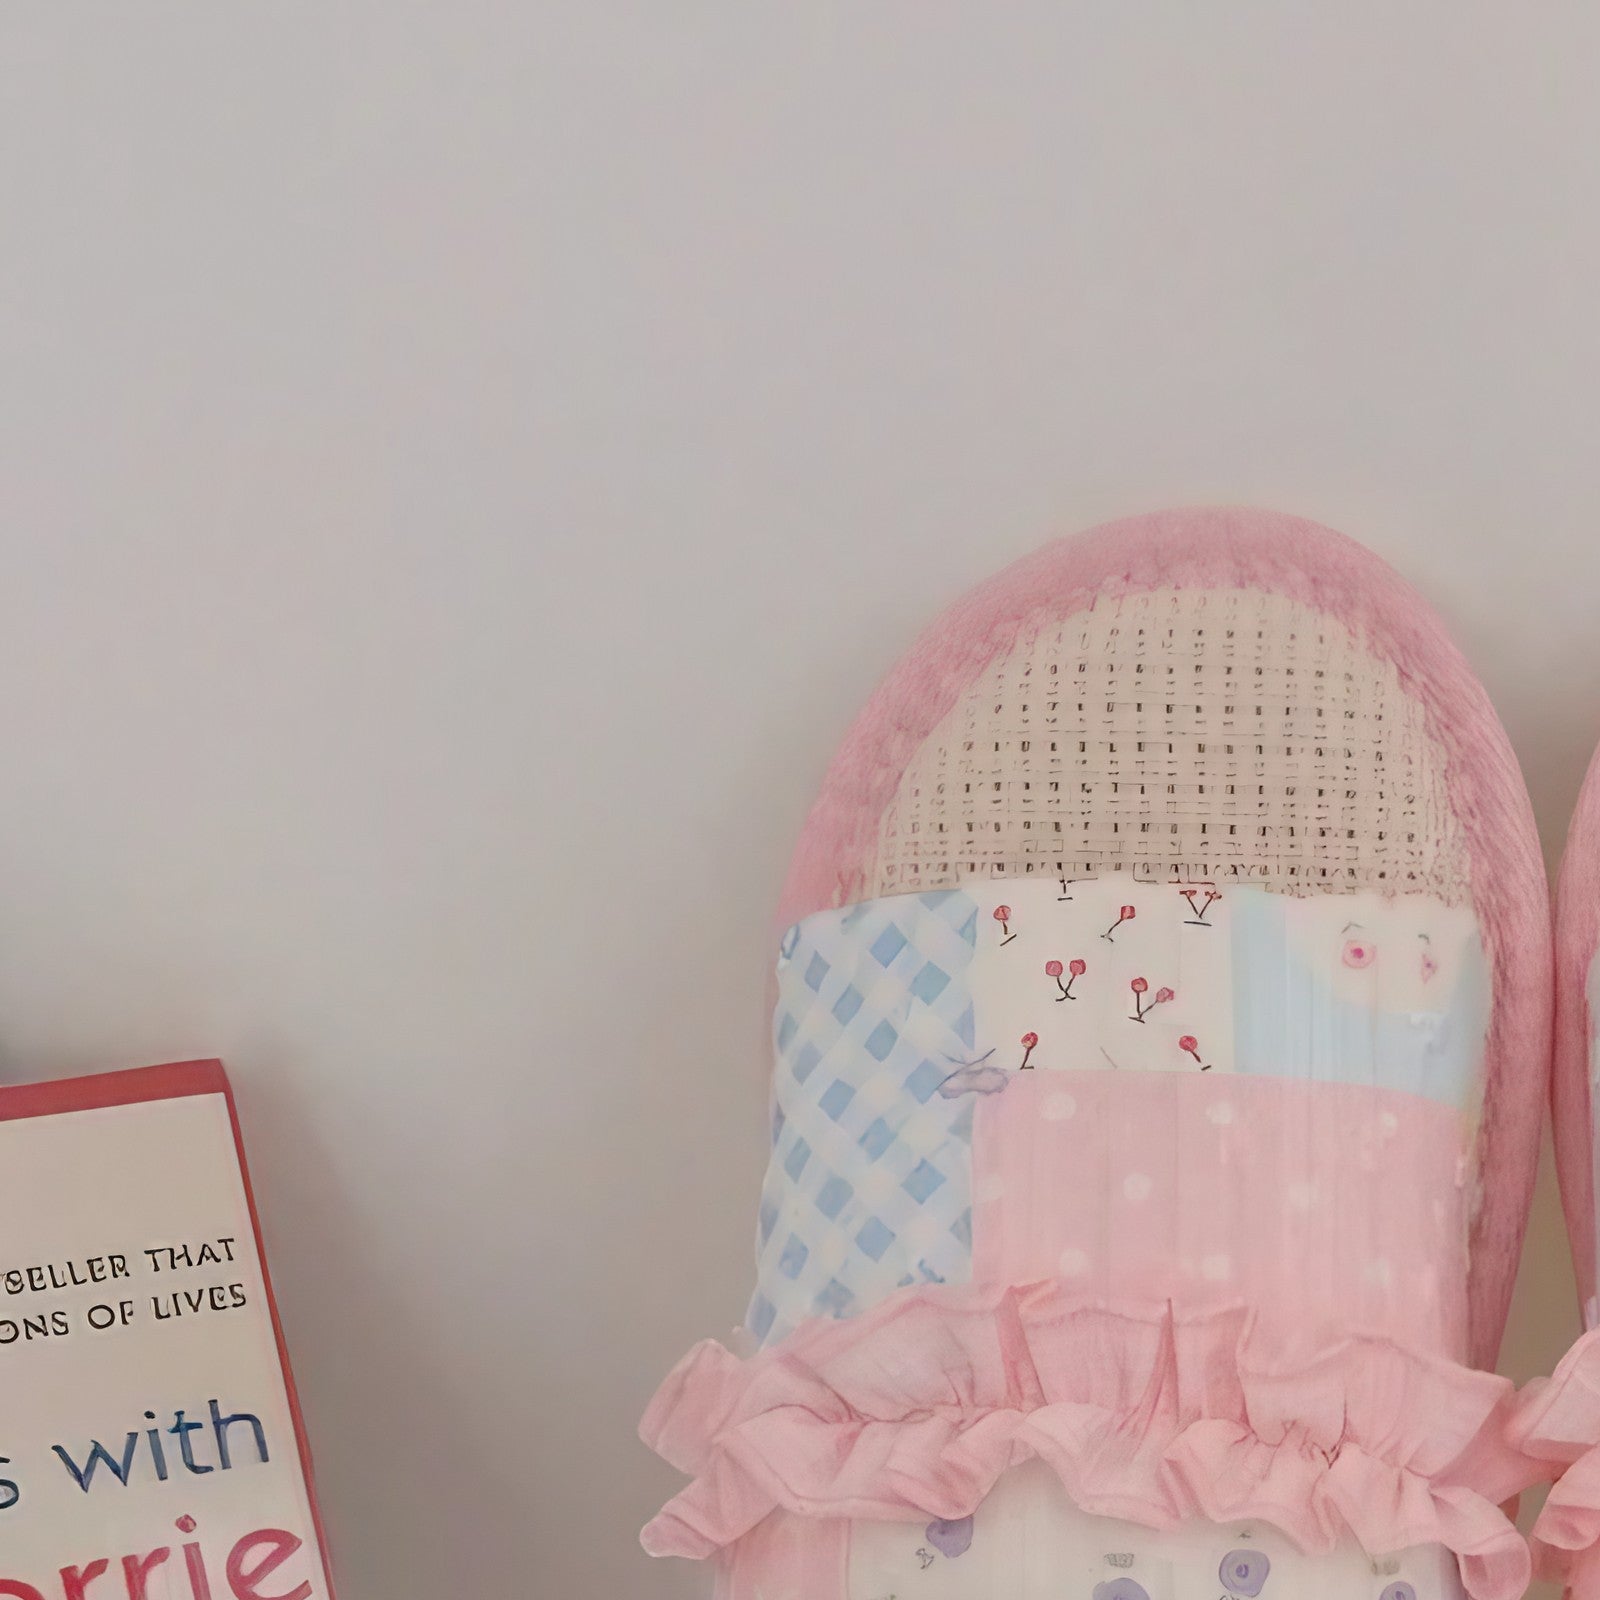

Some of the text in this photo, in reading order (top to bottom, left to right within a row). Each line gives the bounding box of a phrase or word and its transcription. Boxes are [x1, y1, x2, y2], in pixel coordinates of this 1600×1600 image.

[144, 1237, 235, 1273] THAT
[87, 1300, 135, 1330] OF
[151, 1282, 248, 1321] LIVES
[51, 1398, 270, 1494] with
